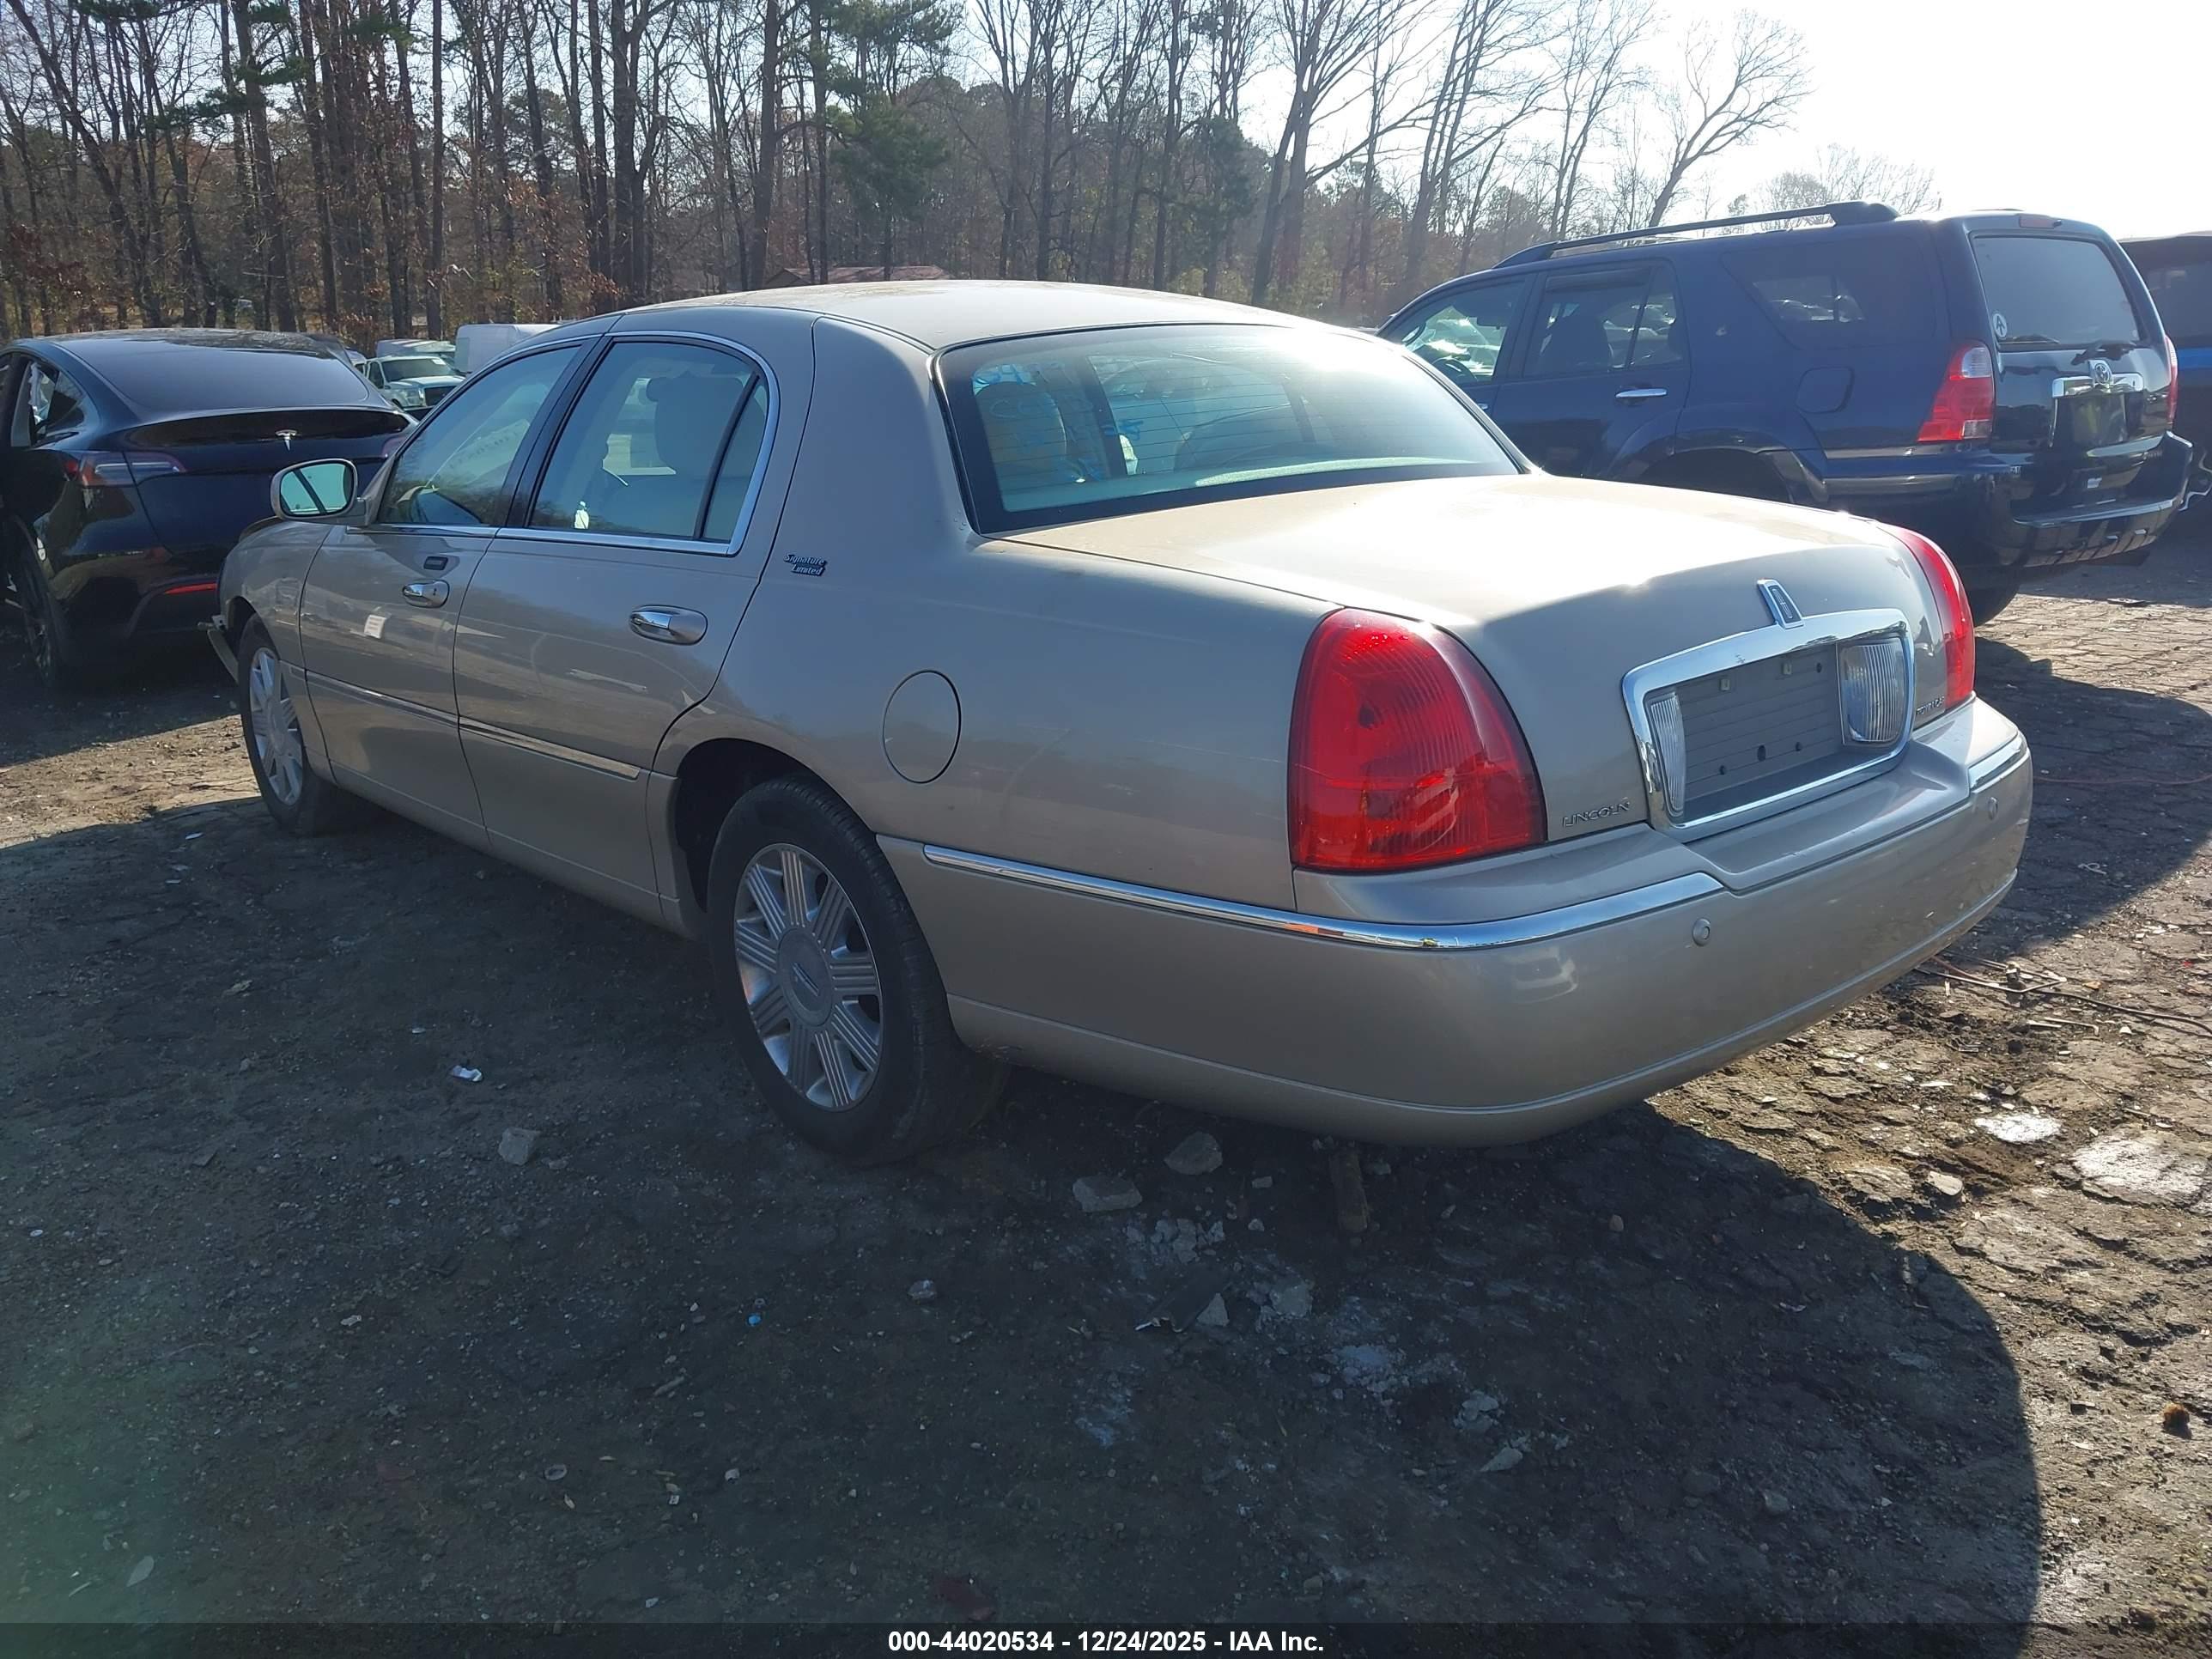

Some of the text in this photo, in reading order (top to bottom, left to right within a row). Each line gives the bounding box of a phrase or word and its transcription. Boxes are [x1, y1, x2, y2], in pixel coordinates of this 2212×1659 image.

[784, 554, 826, 565] Signature
[791, 564, 824, 575] Limited
[1563, 797, 1631, 827] LINCOLN
